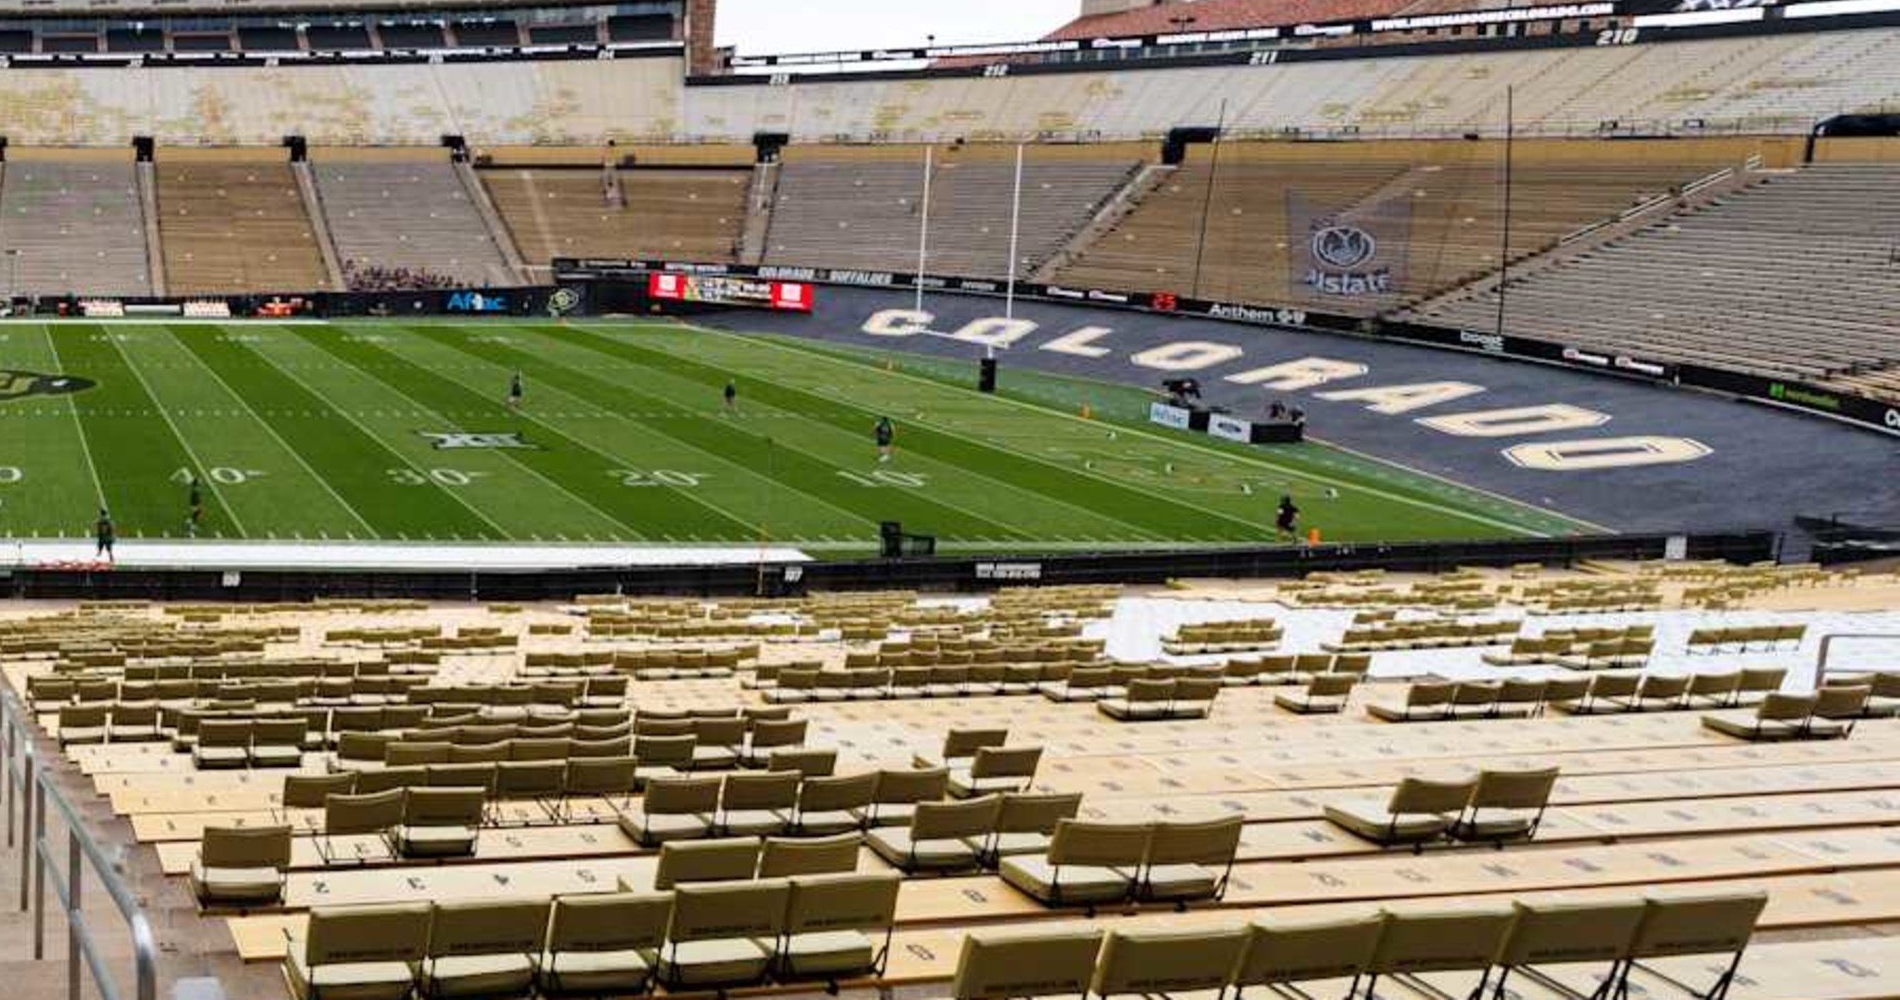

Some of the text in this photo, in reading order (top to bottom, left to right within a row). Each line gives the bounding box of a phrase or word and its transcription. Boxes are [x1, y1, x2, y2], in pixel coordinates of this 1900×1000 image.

[1250, 51, 1277, 65] 211
[1210, 303, 1274, 323] Anthem
[860, 308, 1715, 472] COLORADO
[170, 466, 250, 486] 40
[387, 468, 472, 488] 30
[620, 469, 700, 489] 20
[312, 880, 331, 895] 2
[406, 877, 426, 891] 3
